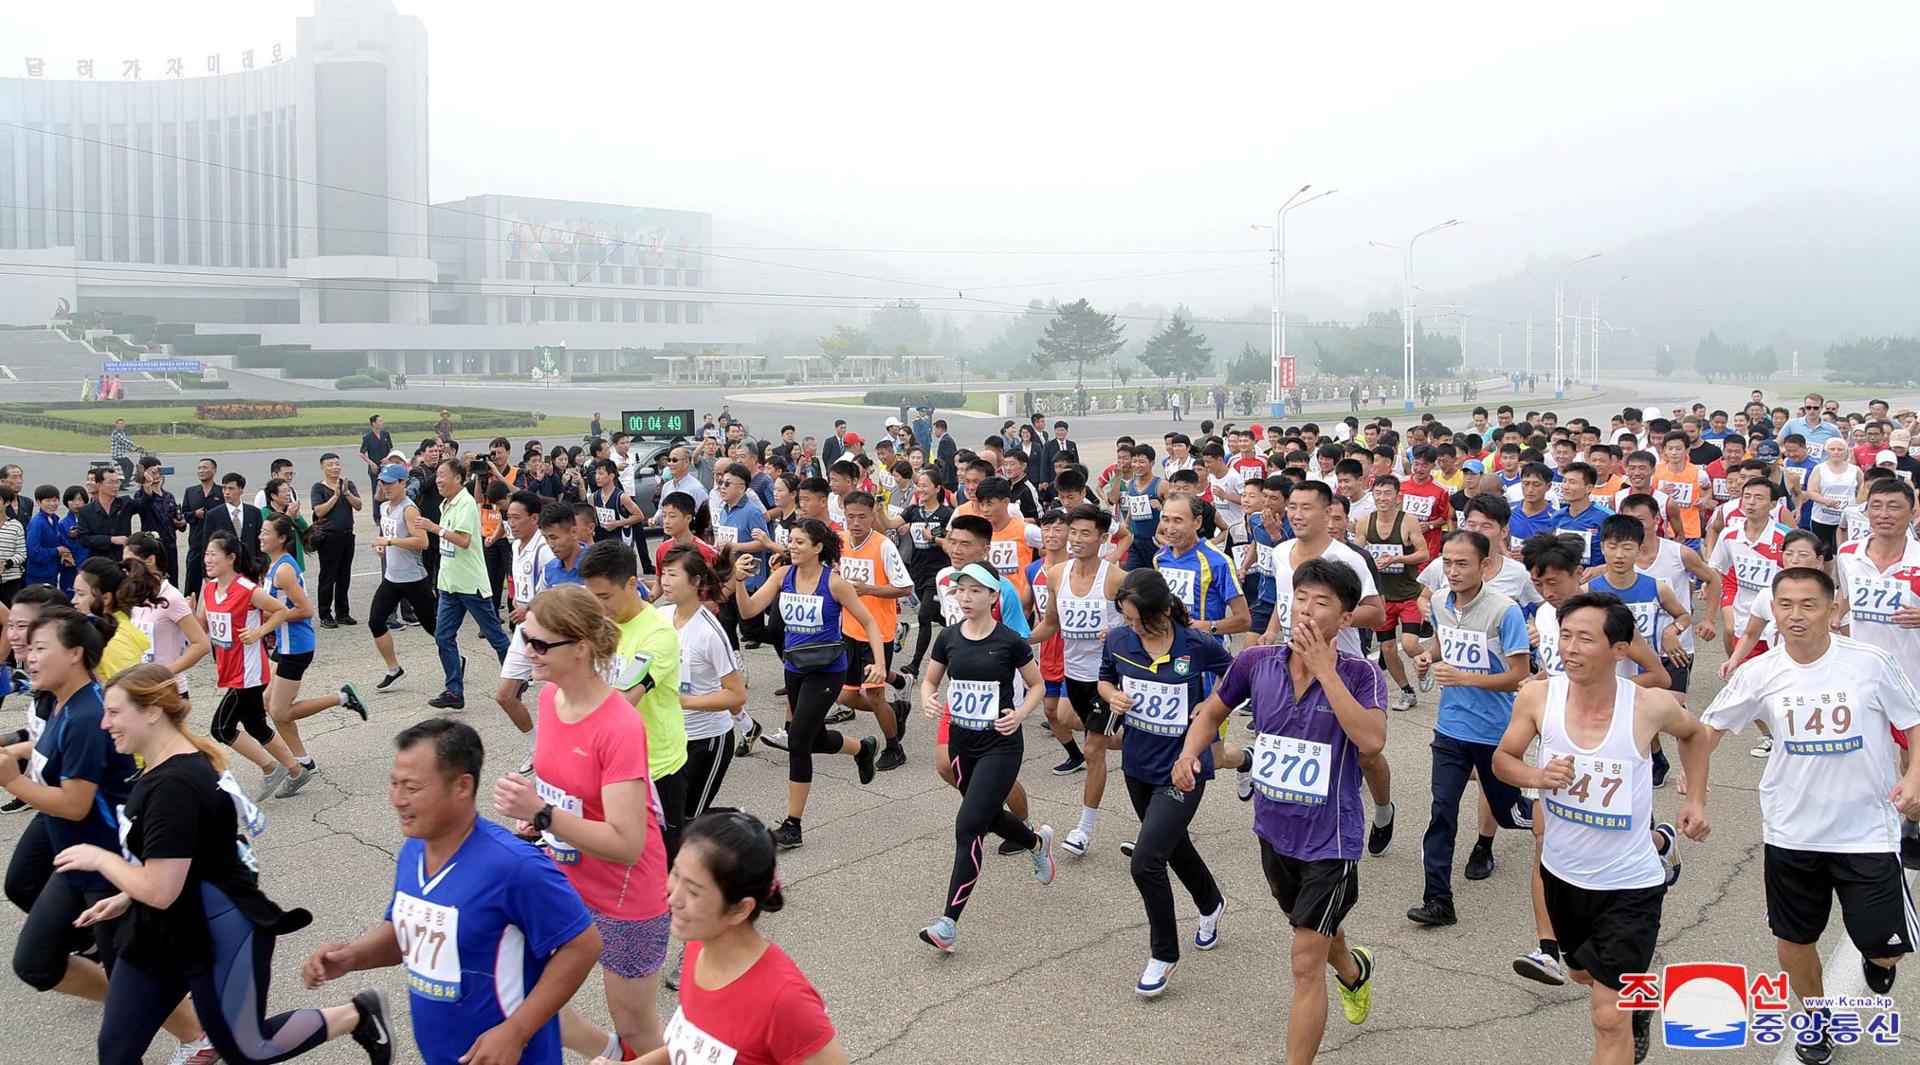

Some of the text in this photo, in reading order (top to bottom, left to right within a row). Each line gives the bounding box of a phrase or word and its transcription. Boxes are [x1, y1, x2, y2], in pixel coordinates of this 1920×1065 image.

[1404, 500, 1429, 514] 192
[1738, 563, 1771, 582] 271
[1853, 587, 1903, 610] 274
[784, 603, 816, 623] 204
[1065, 609, 1101, 629] 225
[1444, 638, 1481, 664] 276
[952, 691, 994, 715] 207
[1130, 692, 1180, 721] 282
[1784, 704, 1852, 737] 149
[1258, 750, 1320, 787] 270
[399, 919, 447, 970] 077
